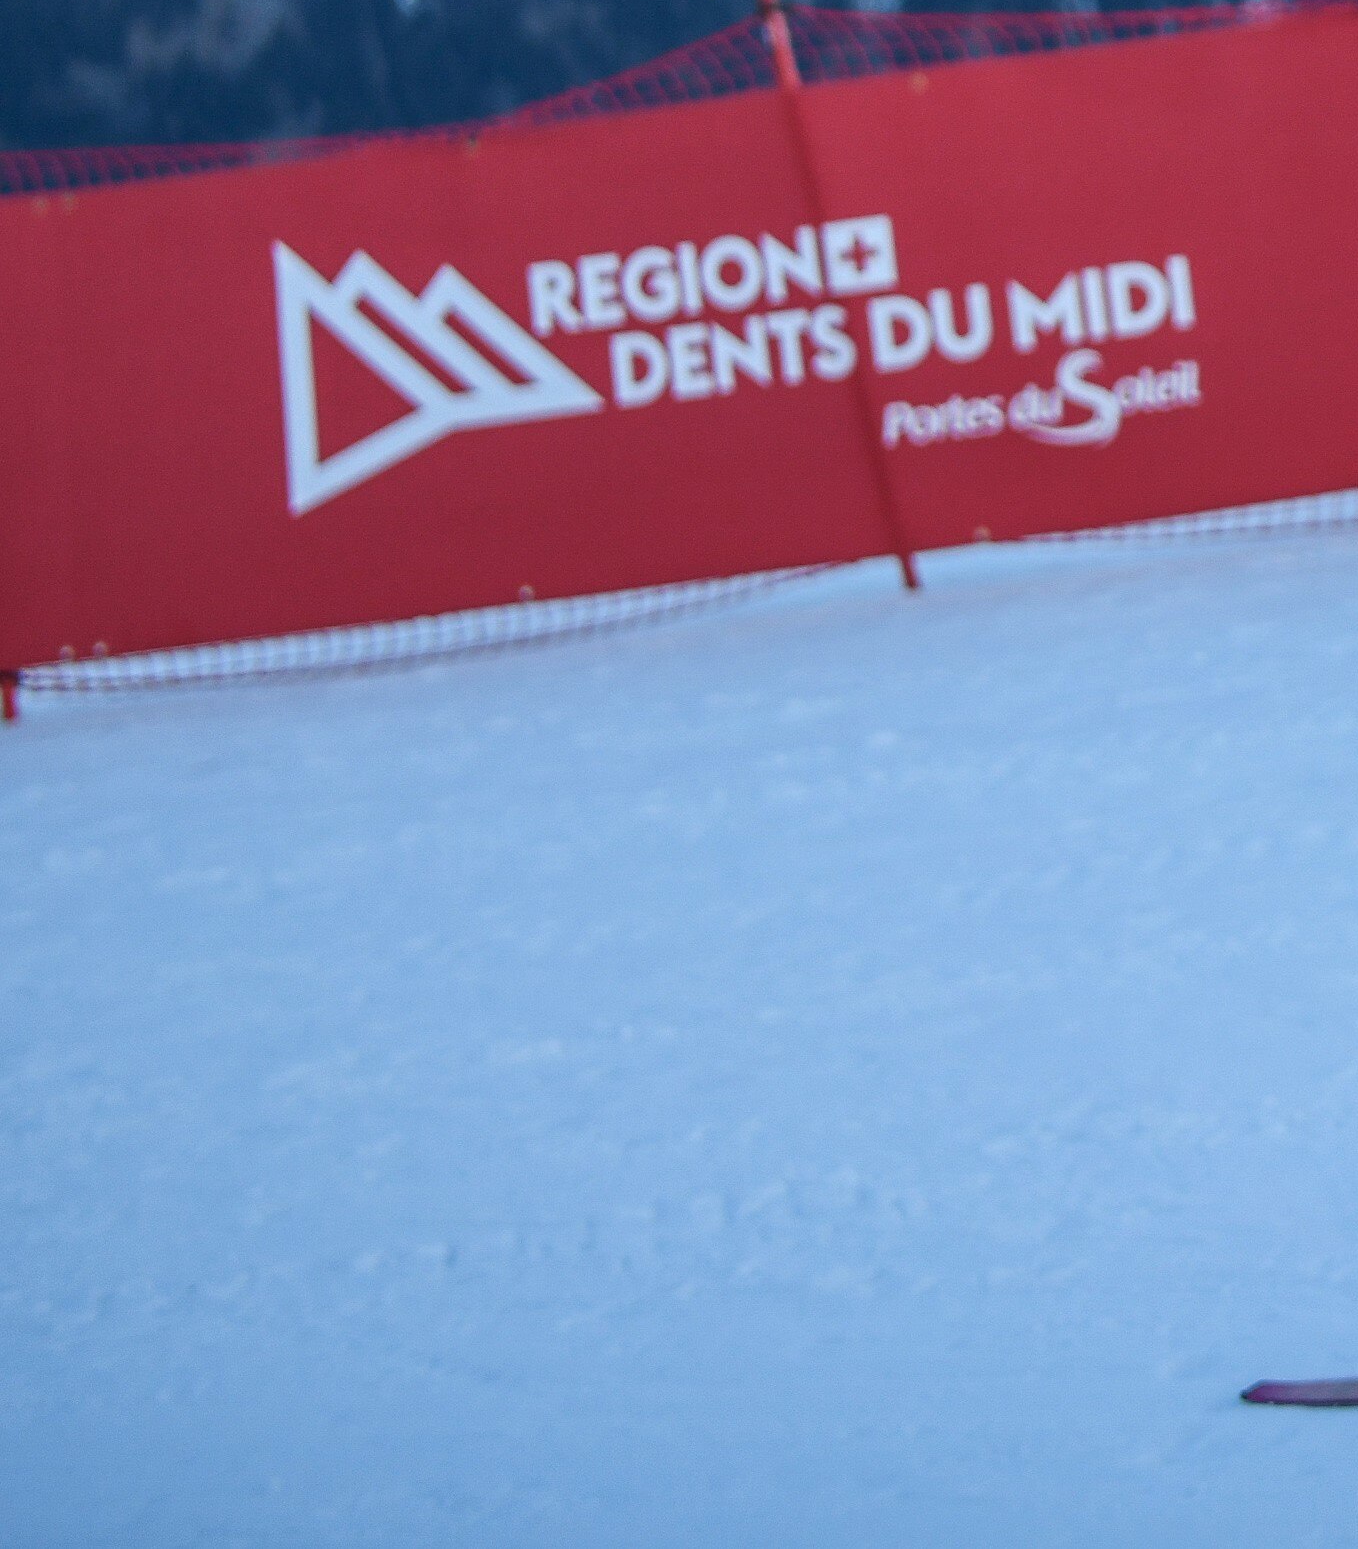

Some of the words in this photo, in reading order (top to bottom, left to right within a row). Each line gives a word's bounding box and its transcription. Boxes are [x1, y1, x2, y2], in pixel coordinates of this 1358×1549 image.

[526, 225, 822, 337] REGION
[608, 303, 859, 408] DENTS
[866, 284, 993, 373] DU
[1007, 254, 1197, 353] MIDI
[882, 395, 1005, 449] Portes
[1008, 382, 1063, 431] du
[1034, 348, 1201, 447] Soleil
